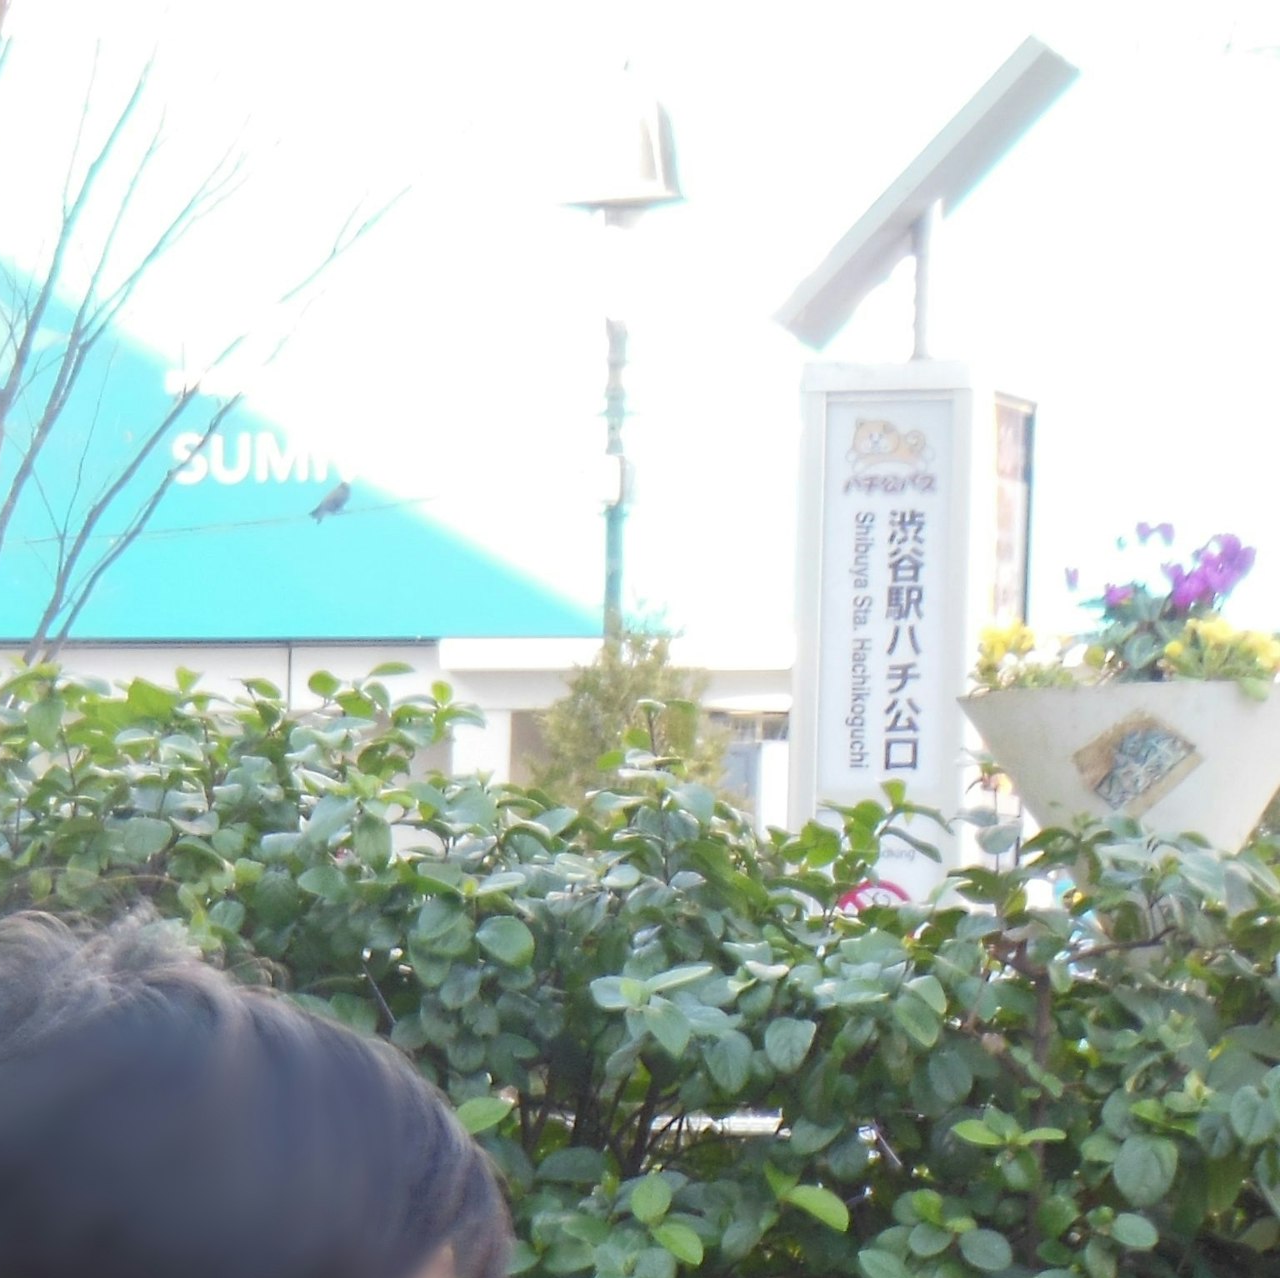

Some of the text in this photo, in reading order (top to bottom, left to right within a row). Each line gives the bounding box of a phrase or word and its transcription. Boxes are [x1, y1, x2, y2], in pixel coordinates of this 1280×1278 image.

[844, 512, 876, 770] Shibuya Sta. Hachikoguchi
[884, 509, 926, 772] 渋谷駅ハチ公口
